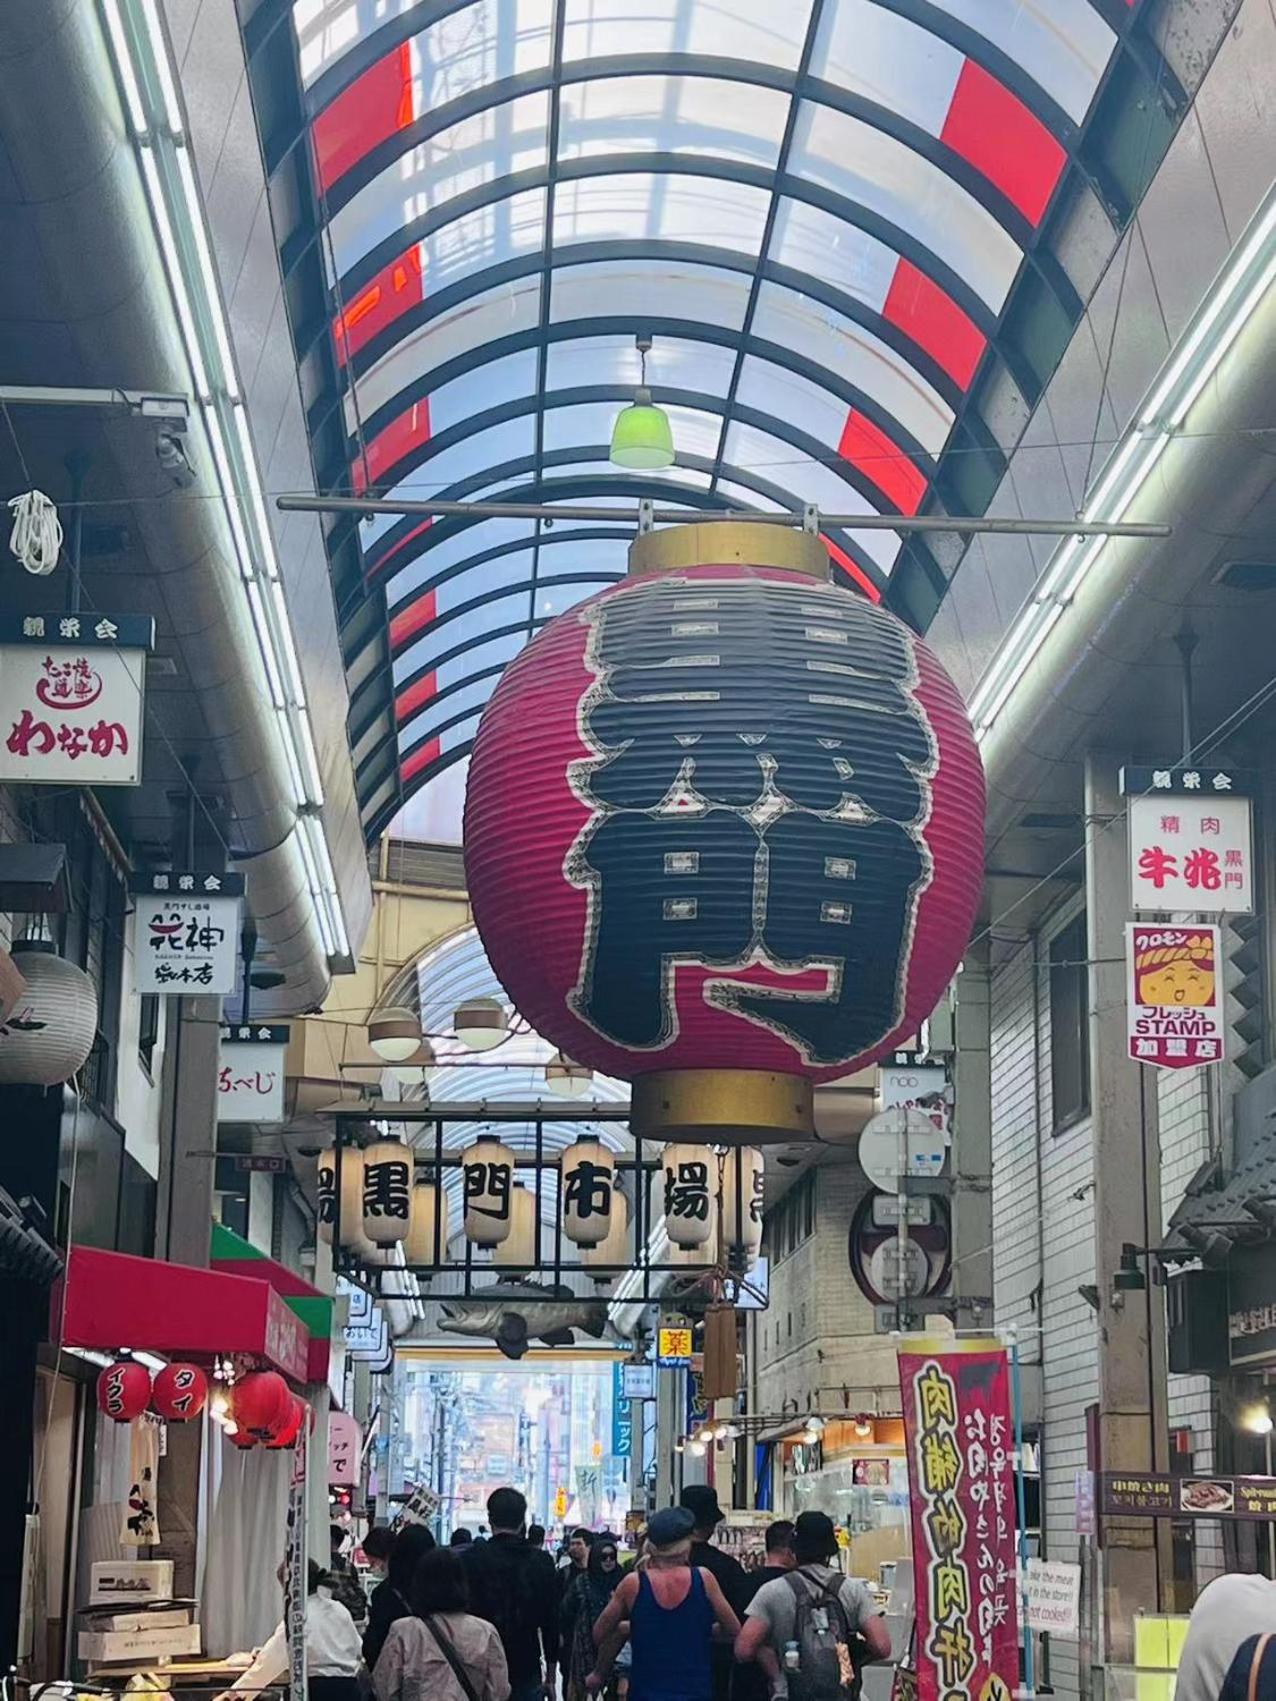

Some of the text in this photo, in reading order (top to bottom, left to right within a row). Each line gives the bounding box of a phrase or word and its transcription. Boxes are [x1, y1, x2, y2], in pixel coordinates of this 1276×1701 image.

[6, 709, 129, 760] わなか
[1160, 815, 1221, 835] 精肉
[1135, 930, 1188, 950] クロモン
[1142, 1006, 1206, 1021] フレッシュ
[1136, 1019, 1217, 1036] STAMP
[1136, 1038, 1217, 1058] 加盟店
[107, 1367, 126, 1413] イクラ
[172, 1368, 195, 1413] タイ
